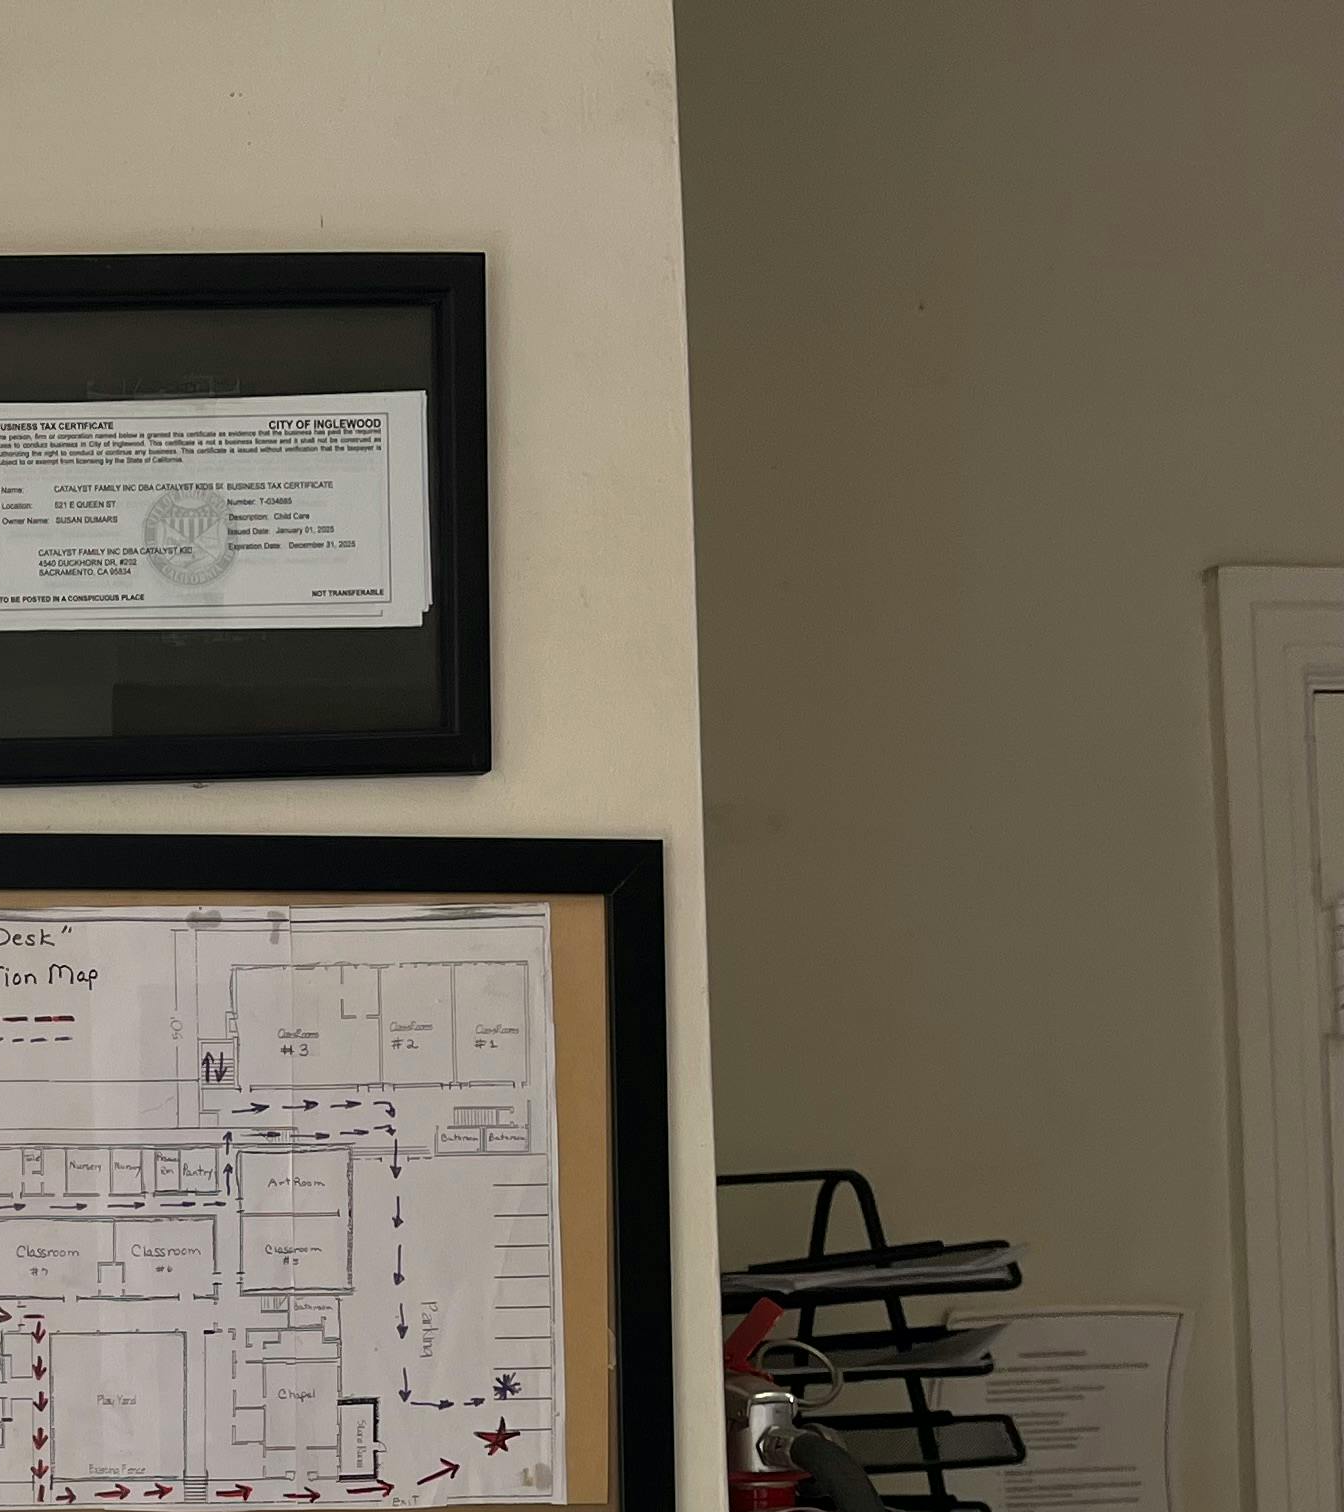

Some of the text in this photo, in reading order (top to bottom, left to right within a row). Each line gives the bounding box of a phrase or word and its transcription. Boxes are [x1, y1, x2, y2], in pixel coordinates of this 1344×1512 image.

[40, 422, 55, 431] TAX
[58, 422, 115, 430] CERTIFICATE
[268, 419, 382, 430] CITY OF INGLEWOOD
[54, 485, 92, 493] CATALYST
[94, 484, 121, 492] FAMILY
[122, 484, 135, 492] INC
[155, 483, 193, 491] CATALYST
[226, 481, 334, 490] BUSINESS TAX CERTIFICATE
[69, 501, 75, 509] E
[76, 501, 104, 509] QUEEN
[105, 500, 117, 509] ST
[288, 541, 324, 549] December
[38, 548, 76, 557] CATALYST
[78, 548, 105, 556] FAMILY
[106, 548, 120, 556] INC
[139, 547, 177, 555] CATALYST
[96, 568, 108, 576] CA
[328, 588, 386, 597] TRANSFERABLE
[0, 593, 145, 604] TO BE POSTED IN A CONSPICUOUS PLACE
[48, 963, 99, 991] Map
[16, 1245, 80, 1258] Classroom
[131, 1244, 202, 1257] Classroom
[265, 1244, 322, 1255] Classroom
[278, 1388, 317, 1402] Chapel
